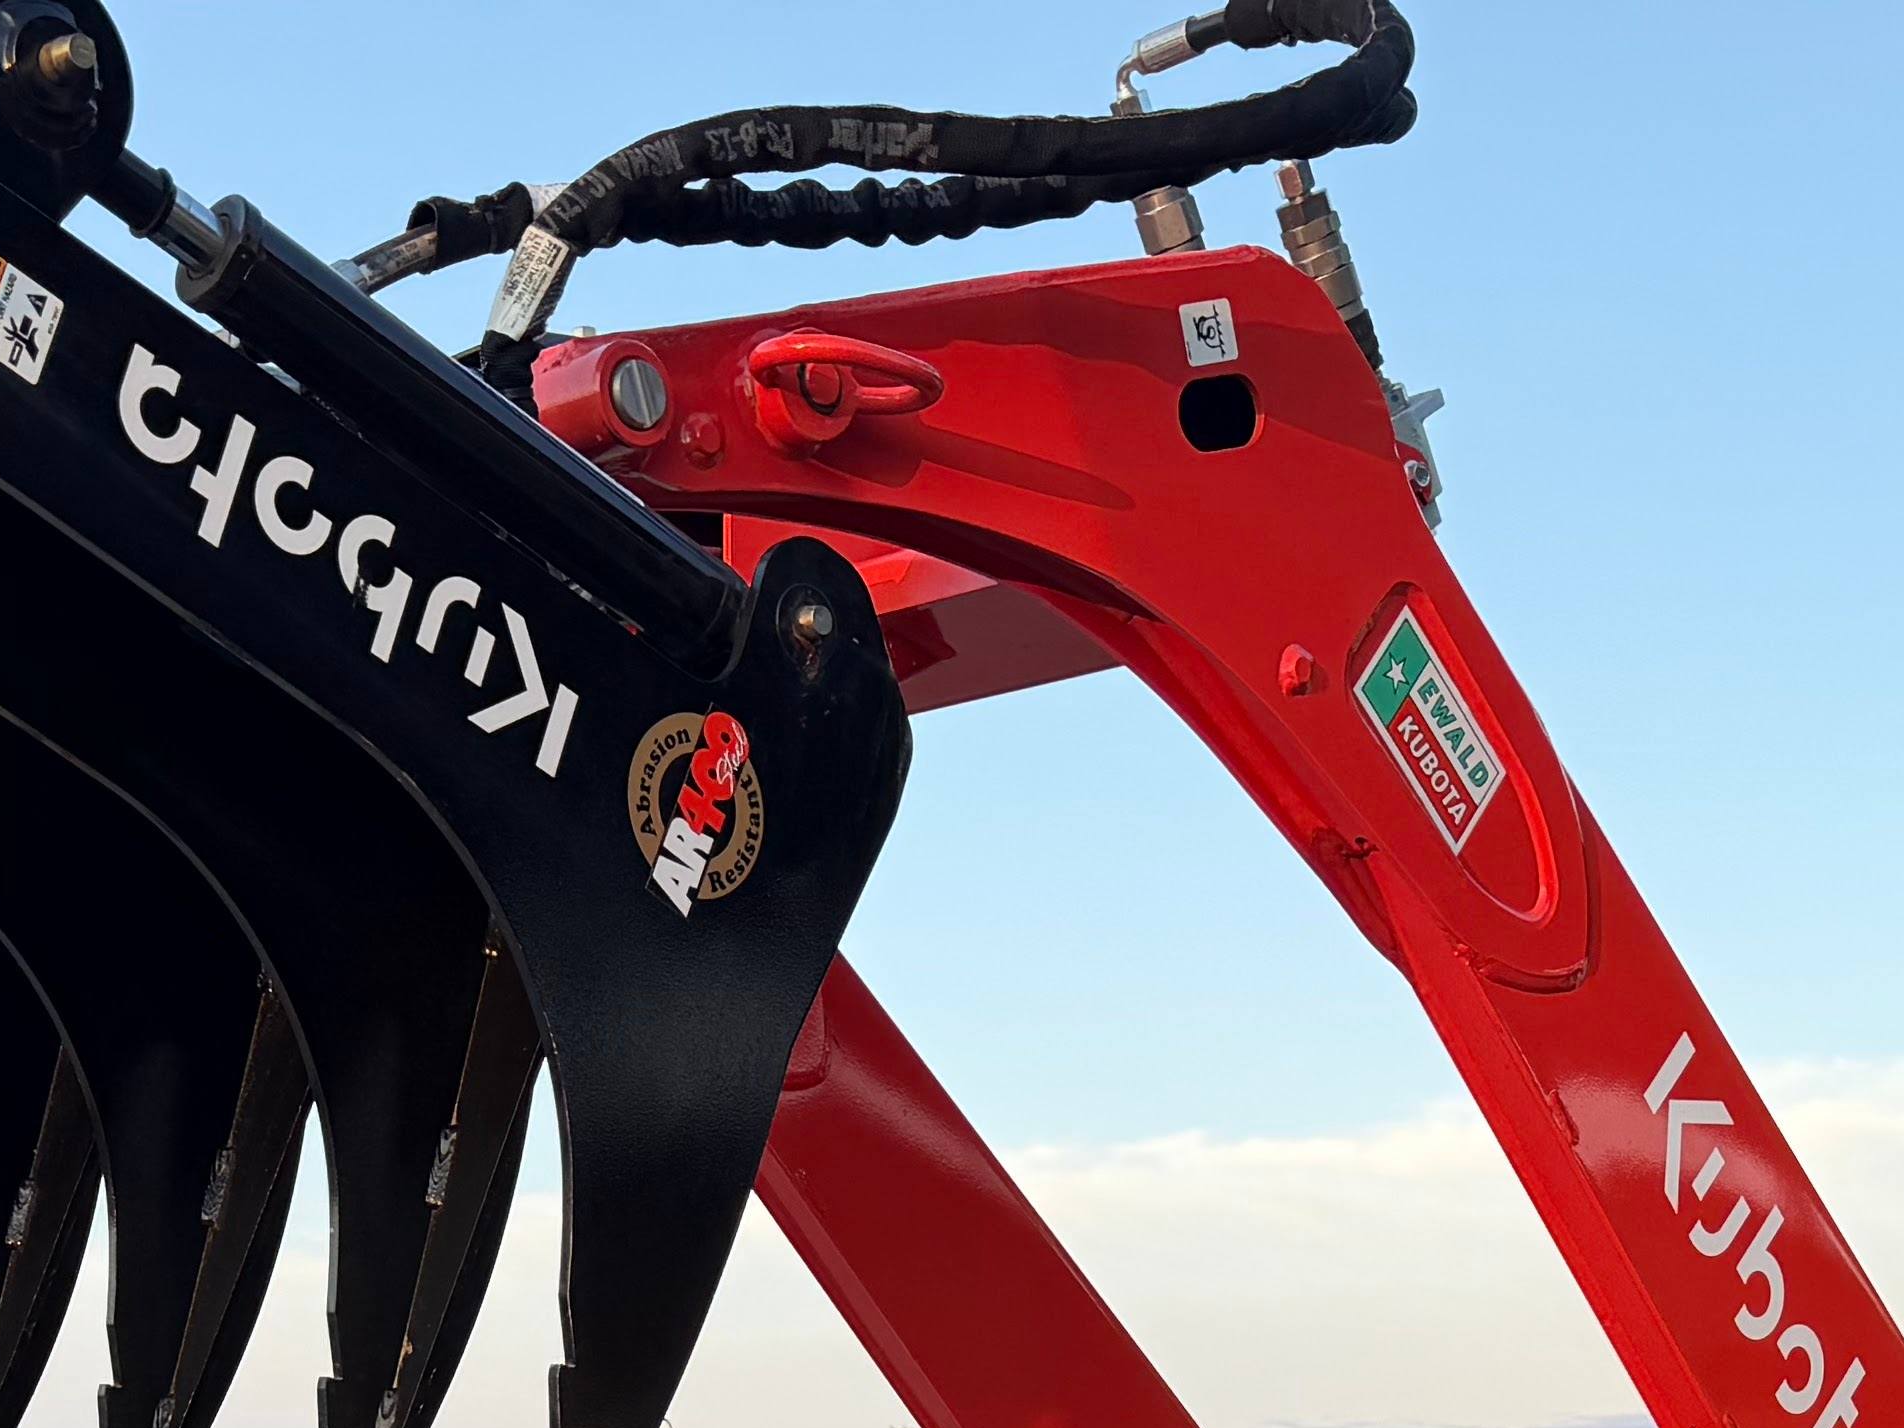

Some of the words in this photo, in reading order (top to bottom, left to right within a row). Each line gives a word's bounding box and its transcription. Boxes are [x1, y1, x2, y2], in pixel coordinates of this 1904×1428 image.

[118, 343, 579, 778] Kubota
[637, 727, 692, 837] Abrasion
[1397, 715, 1468, 826] KUBOTA
[1416, 678, 1489, 787] EWALD
[652, 711, 750, 918] AR400
[708, 774, 761, 893] Resistant
